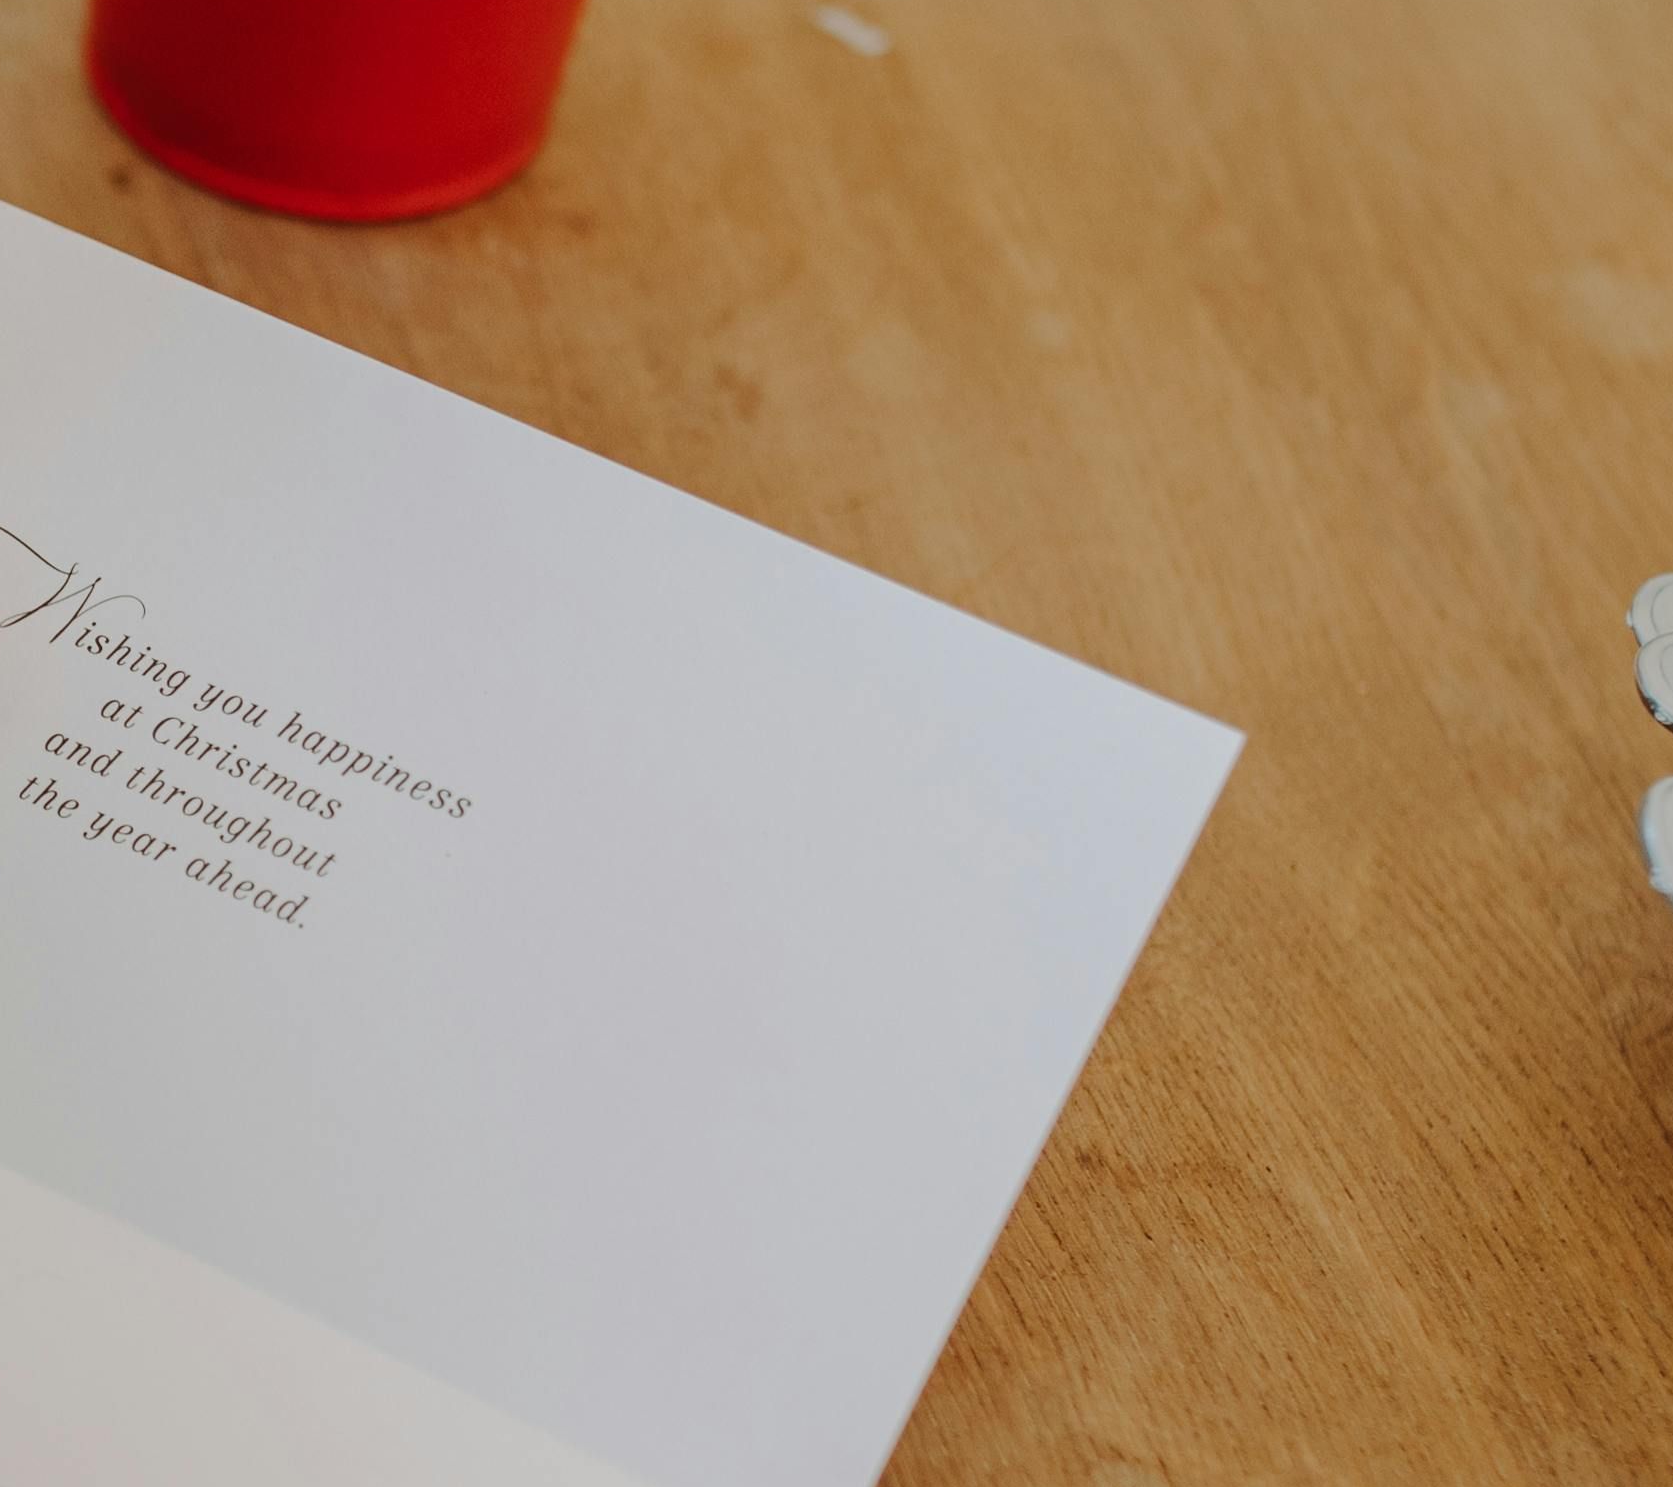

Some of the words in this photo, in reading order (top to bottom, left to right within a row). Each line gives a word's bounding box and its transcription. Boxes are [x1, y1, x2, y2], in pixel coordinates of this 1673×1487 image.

[44, 732, 124, 778] and
[125, 764, 338, 879] throughout
[100, 698, 145, 730] at
[151, 715, 342, 821] Christmas
[192, 681, 269, 730] you
[276, 712, 472, 820] happiness
[18, 776, 80, 819] the
[82, 811, 178, 862] year
[184, 857, 311, 930] ahead.
